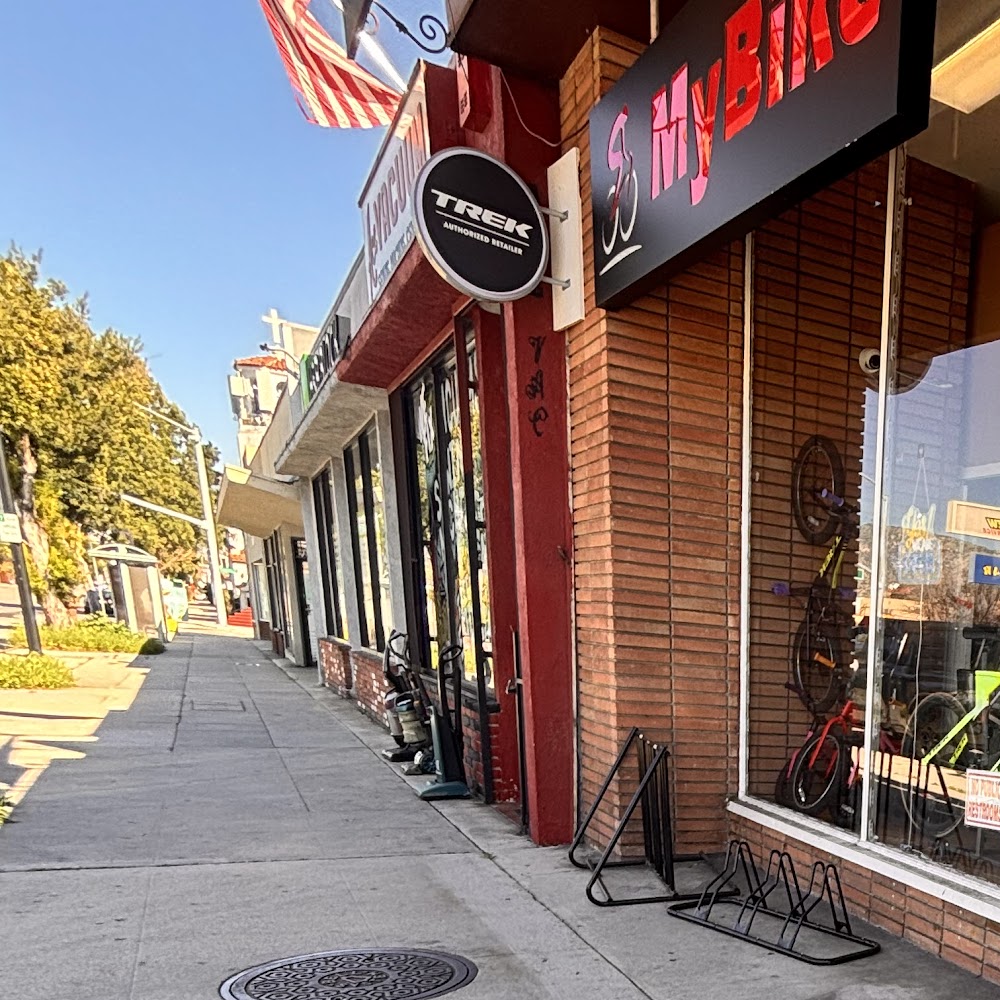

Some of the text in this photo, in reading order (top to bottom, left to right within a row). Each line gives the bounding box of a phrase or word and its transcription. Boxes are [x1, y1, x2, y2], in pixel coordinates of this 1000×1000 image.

[431, 188, 533, 240] TREK
[443, 221, 490, 244] AUTHORIZED
[491, 238, 523, 256] RETAILER
